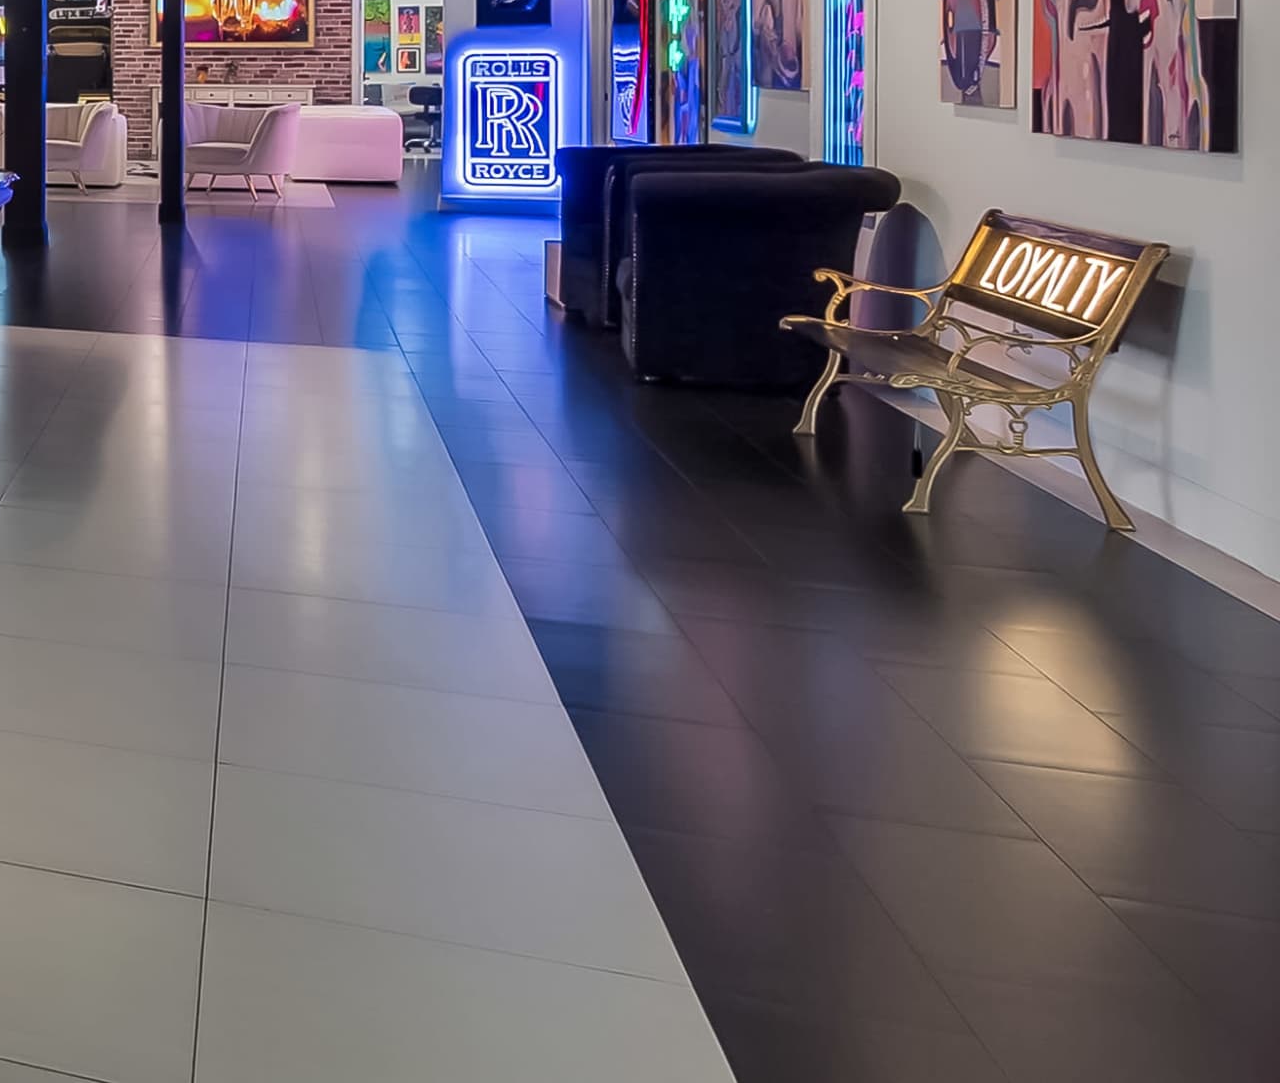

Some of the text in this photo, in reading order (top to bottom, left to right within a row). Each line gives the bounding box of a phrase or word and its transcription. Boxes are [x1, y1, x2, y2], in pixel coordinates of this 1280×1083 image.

[475, 61, 545, 76] ROLLS
[475, 164, 545, 179] ROYCE
[979, 236, 1127, 321] LOYALTY
